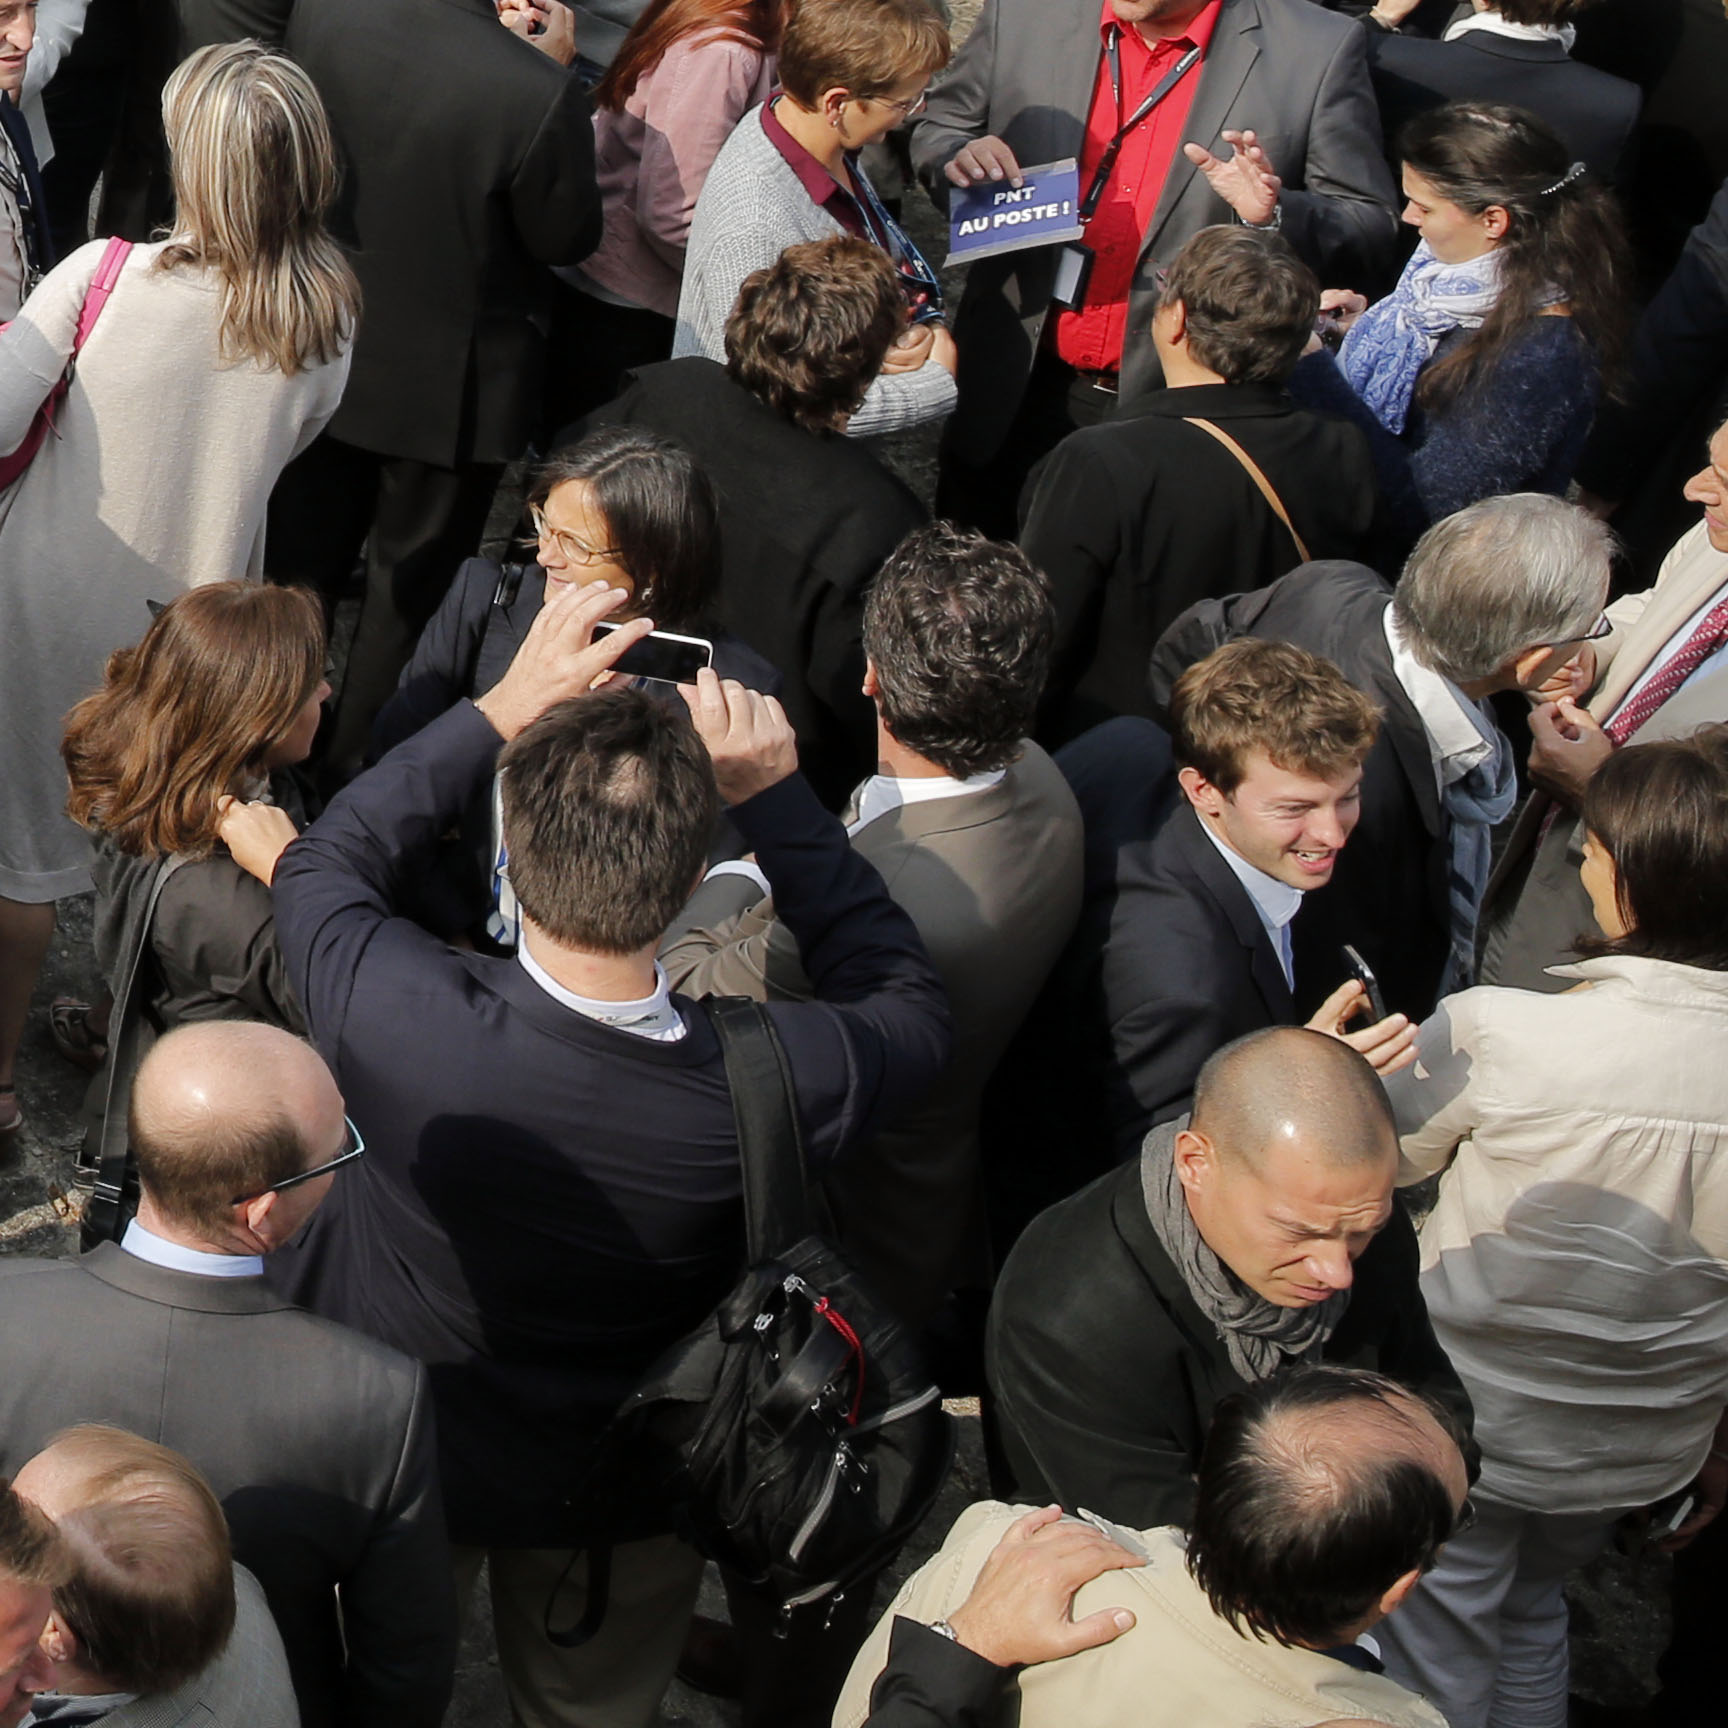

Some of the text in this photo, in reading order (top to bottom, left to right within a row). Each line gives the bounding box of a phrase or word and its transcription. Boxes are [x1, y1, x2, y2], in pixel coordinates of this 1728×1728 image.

[994, 186, 1036, 205] PNT
[958, 201, 1070, 236] AU POSTE !
